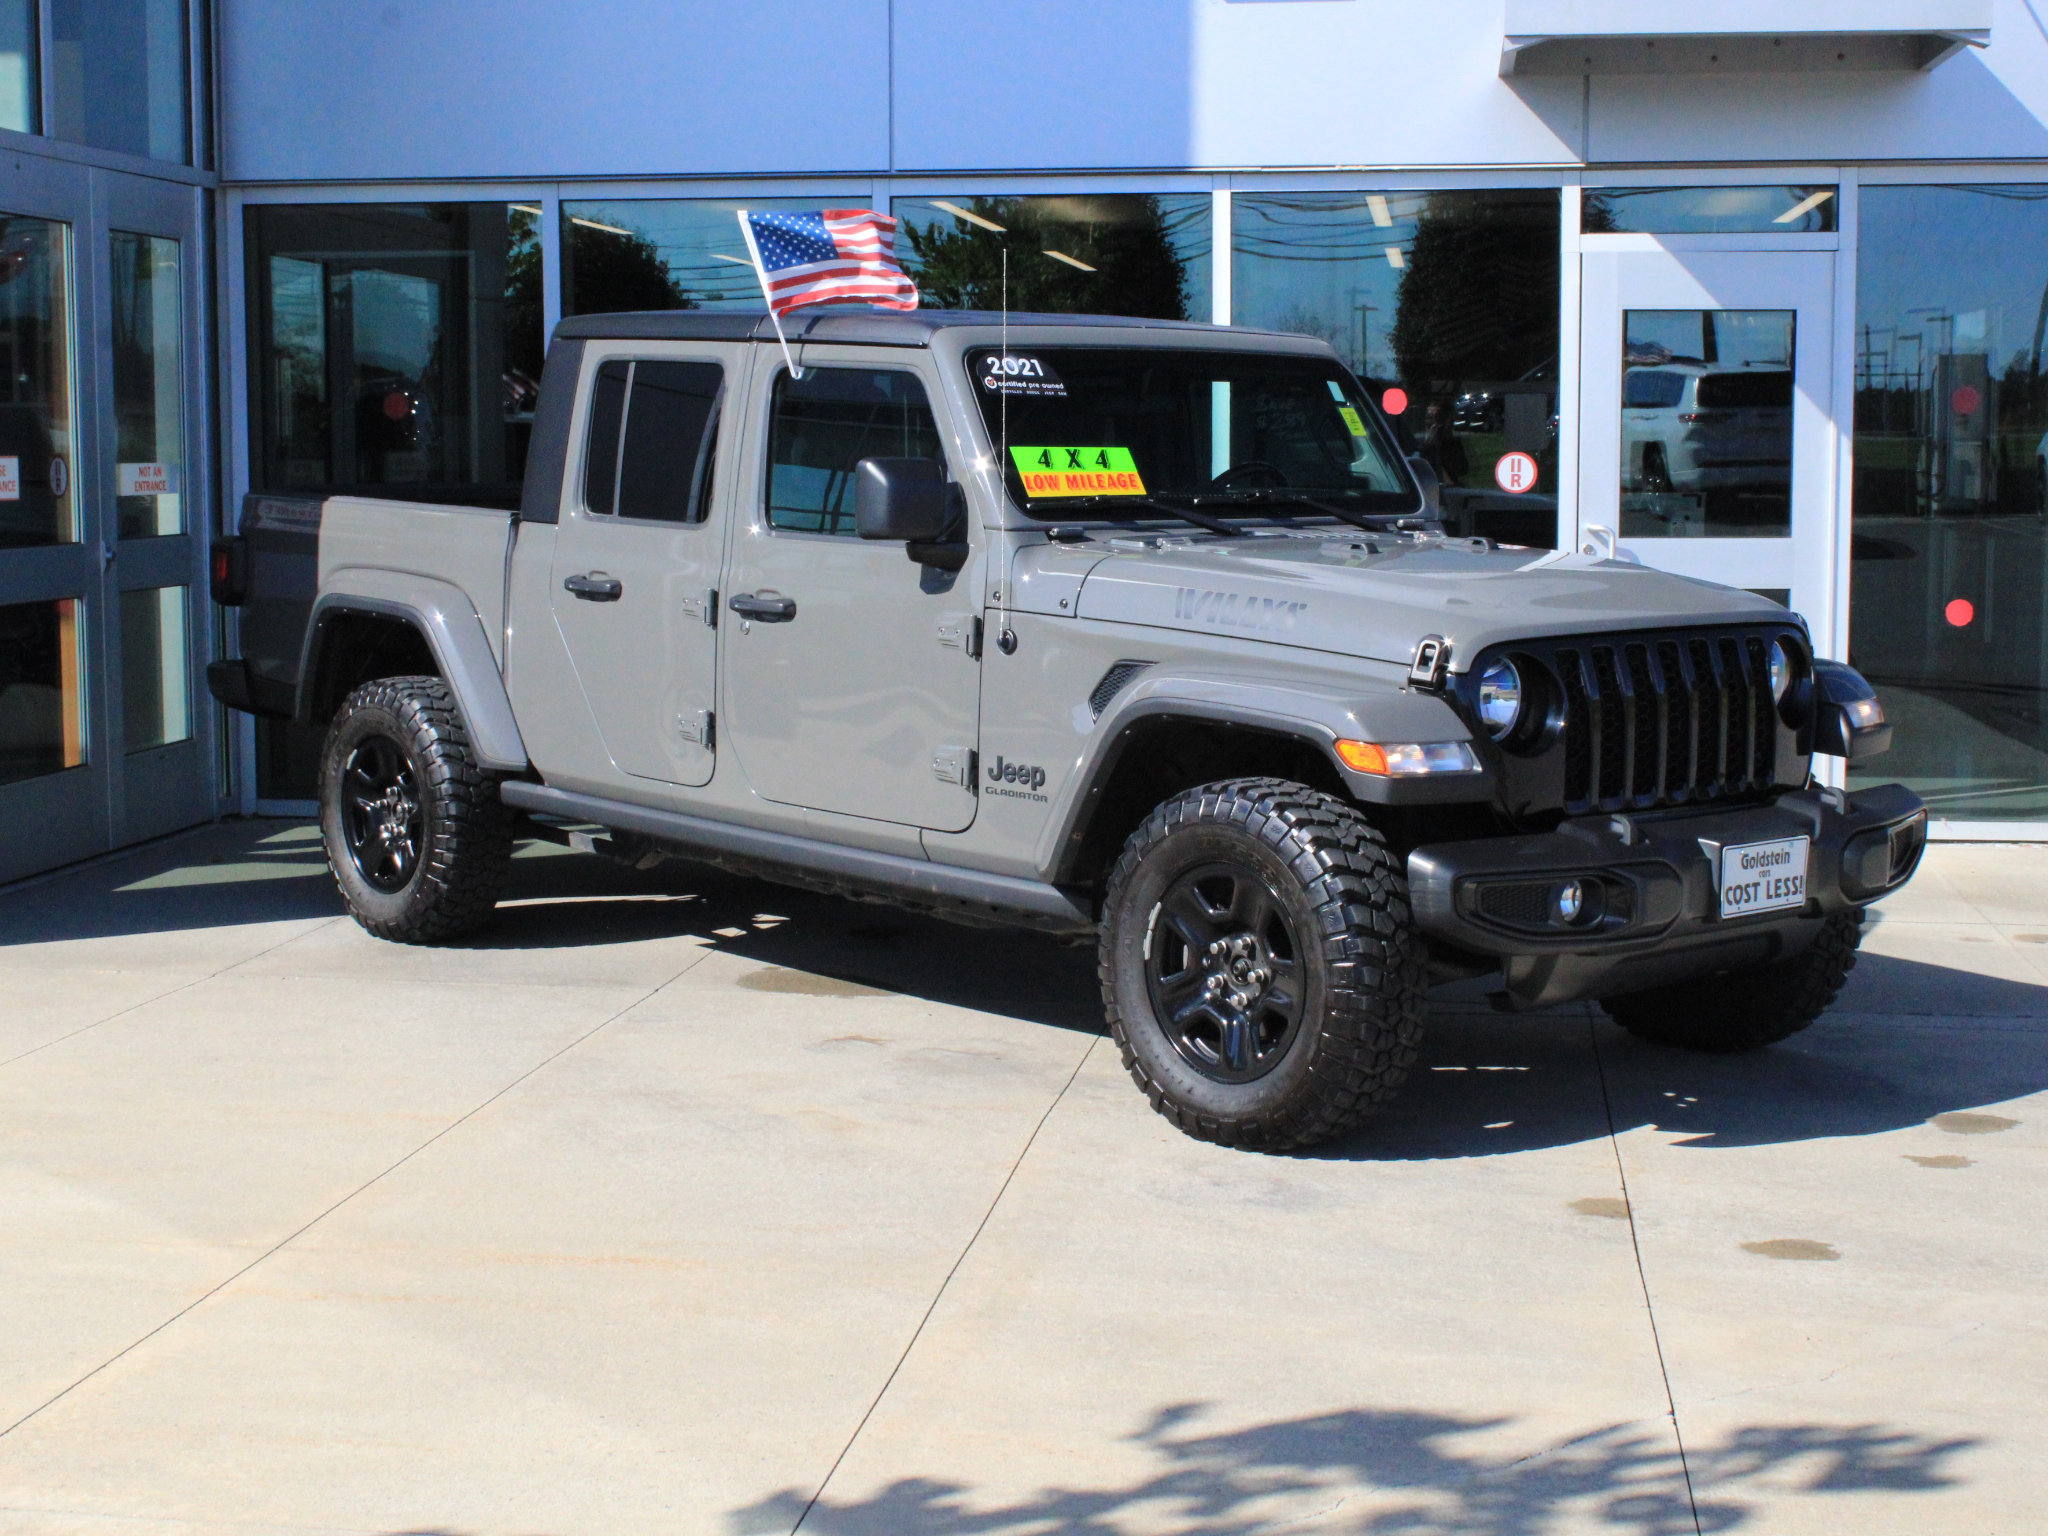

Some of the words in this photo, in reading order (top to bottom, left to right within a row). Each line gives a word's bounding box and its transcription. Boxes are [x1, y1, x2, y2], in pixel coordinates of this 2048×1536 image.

[987, 357, 1044, 376] 2021
[1037, 448, 1054, 470] 4
[1065, 448, 1086, 470] X
[1095, 449, 1112, 470] 4
[138, 466, 151, 477] NOT
[153, 466, 163, 477] AN
[1510, 473, 1522, 488] R
[134, 480, 168, 492] ENTRANCE
[1023, 474, 1060, 492] LOW
[1064, 473, 1140, 491] MILEAGE
[987, 755, 1046, 791] Jeep
[985, 786, 1049, 803] GLADIATOR
[1741, 848, 1791, 870] Goldstein
[1725, 882, 1761, 906] COST
[1765, 875, 1804, 900] LESS!
